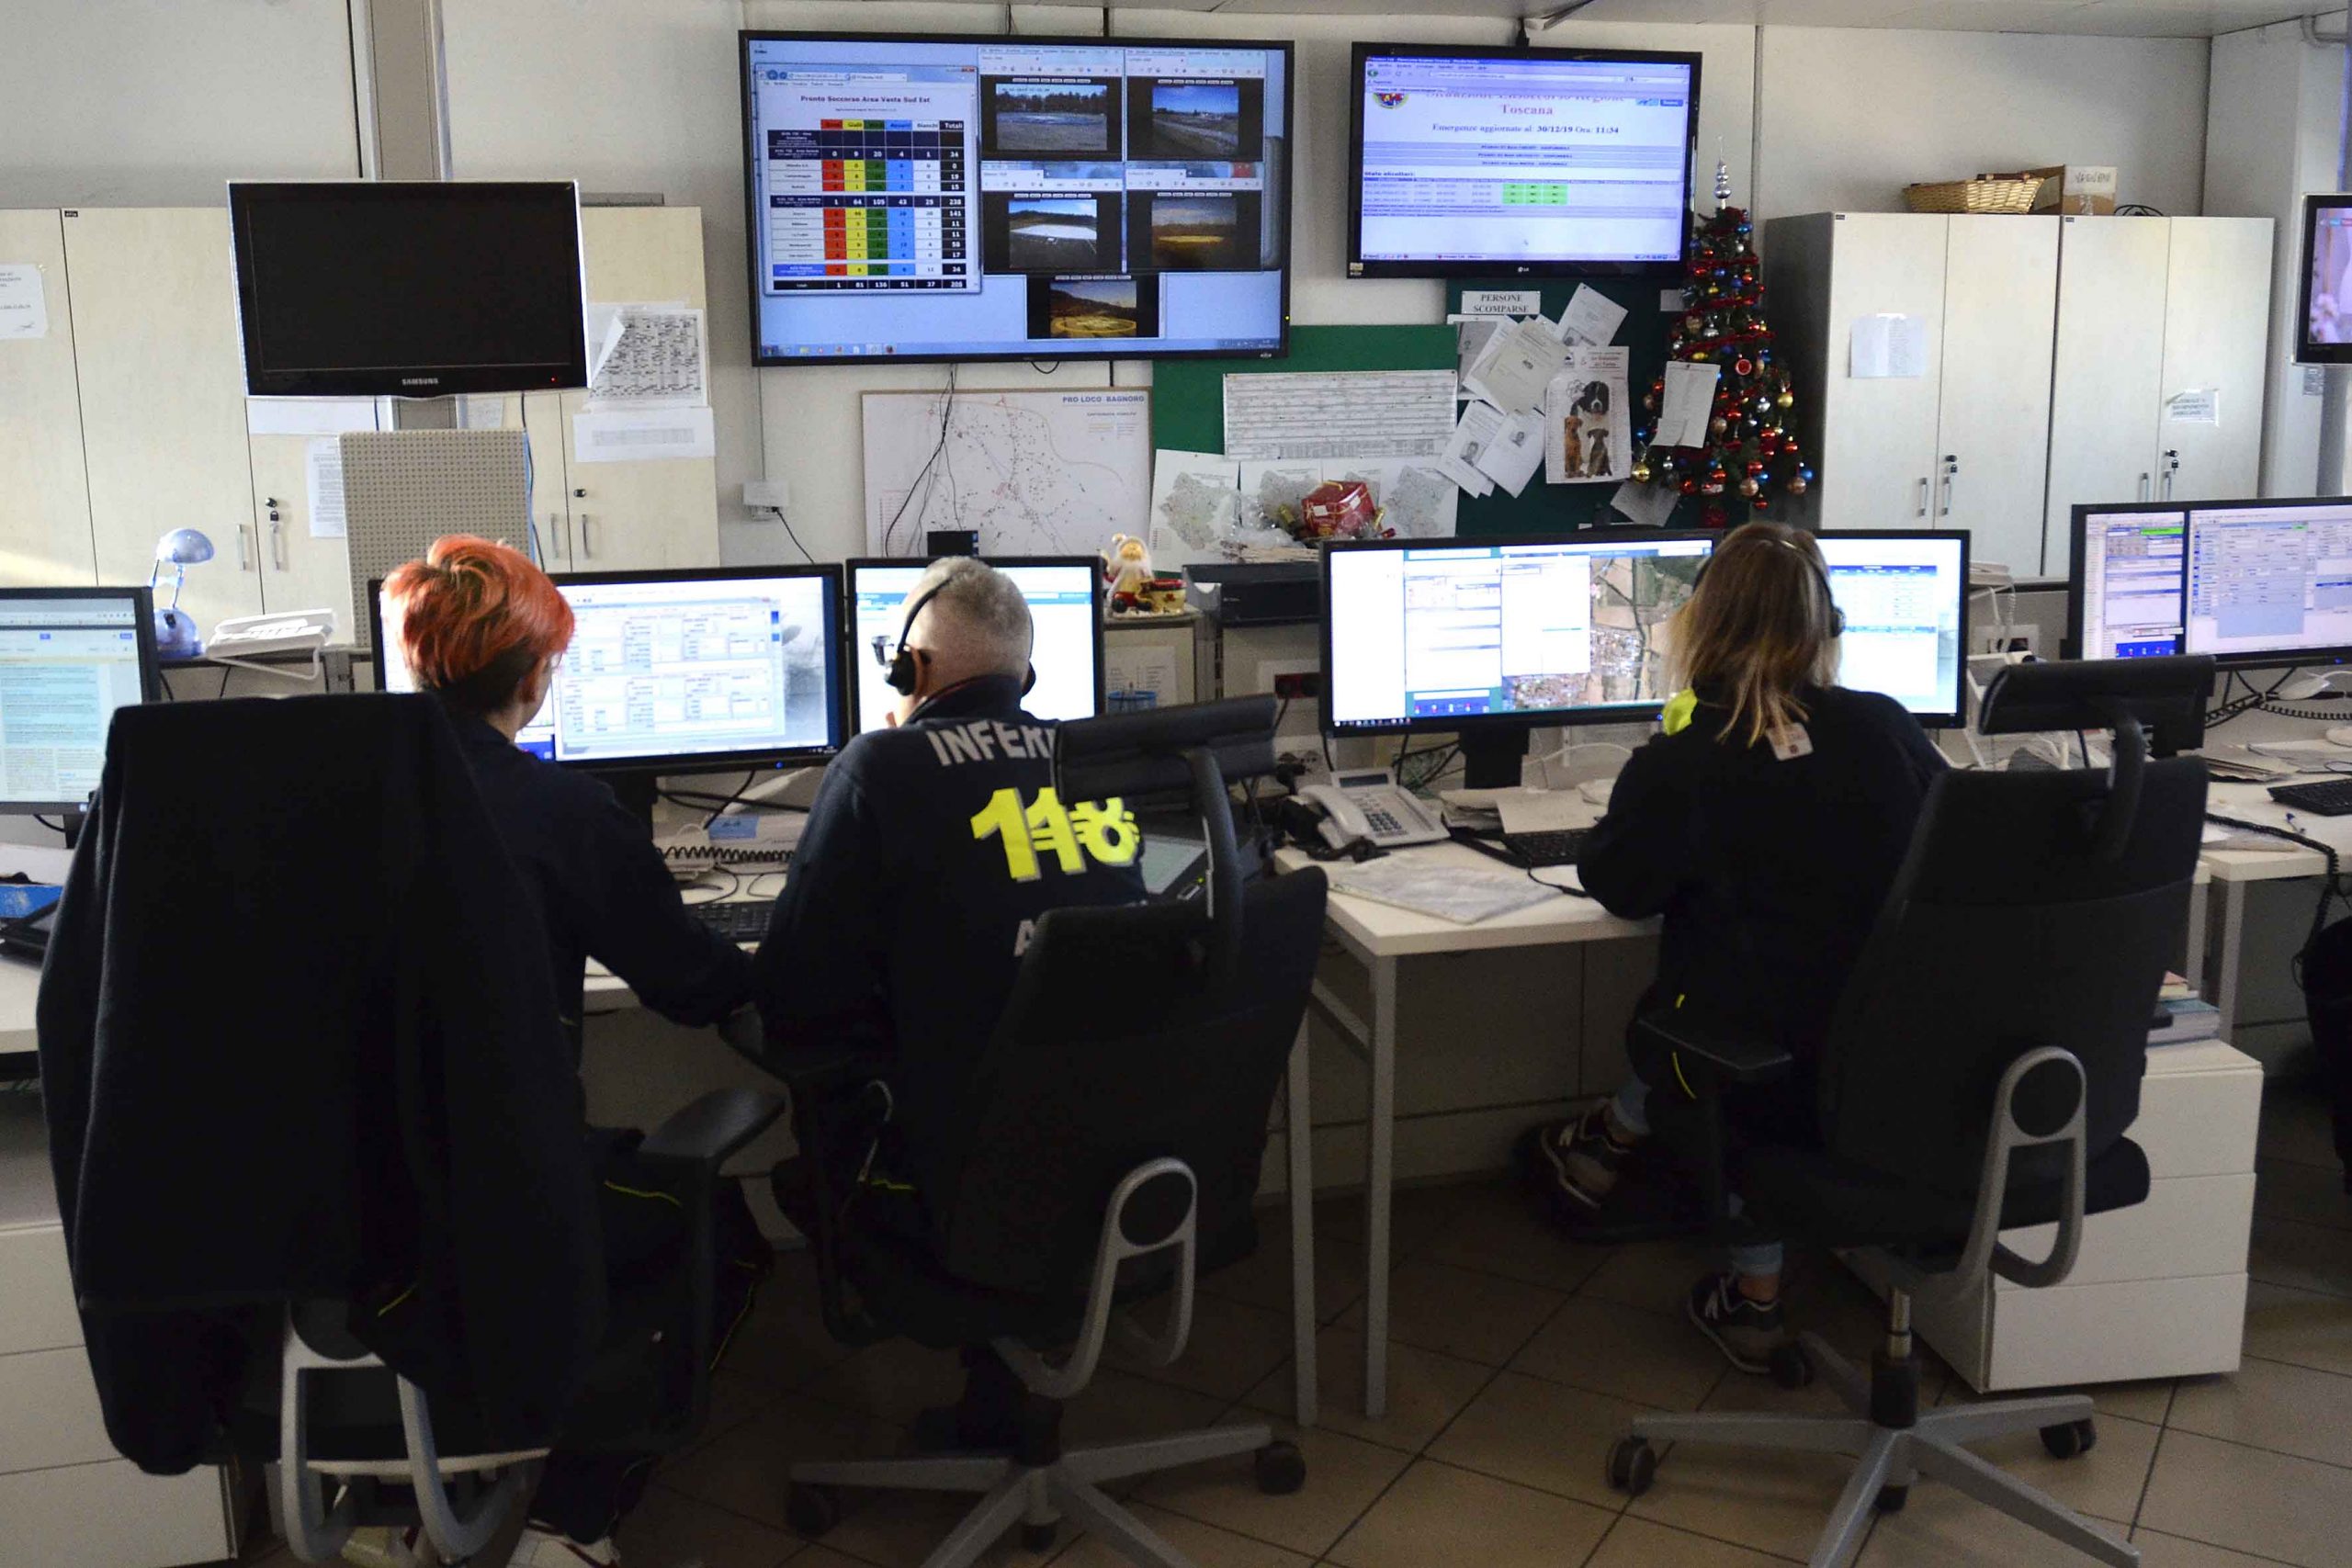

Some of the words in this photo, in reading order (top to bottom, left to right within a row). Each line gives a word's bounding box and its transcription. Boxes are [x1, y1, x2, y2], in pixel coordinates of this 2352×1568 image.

[800, 95, 825, 103] Pronto
[1501, 103, 1554, 116] Toscana
[1536, 125, 1573, 133] 30/12/19
[1474, 305, 1529, 313] SCOMPARSE
[401, 378, 439, 386] SAMSUNG
